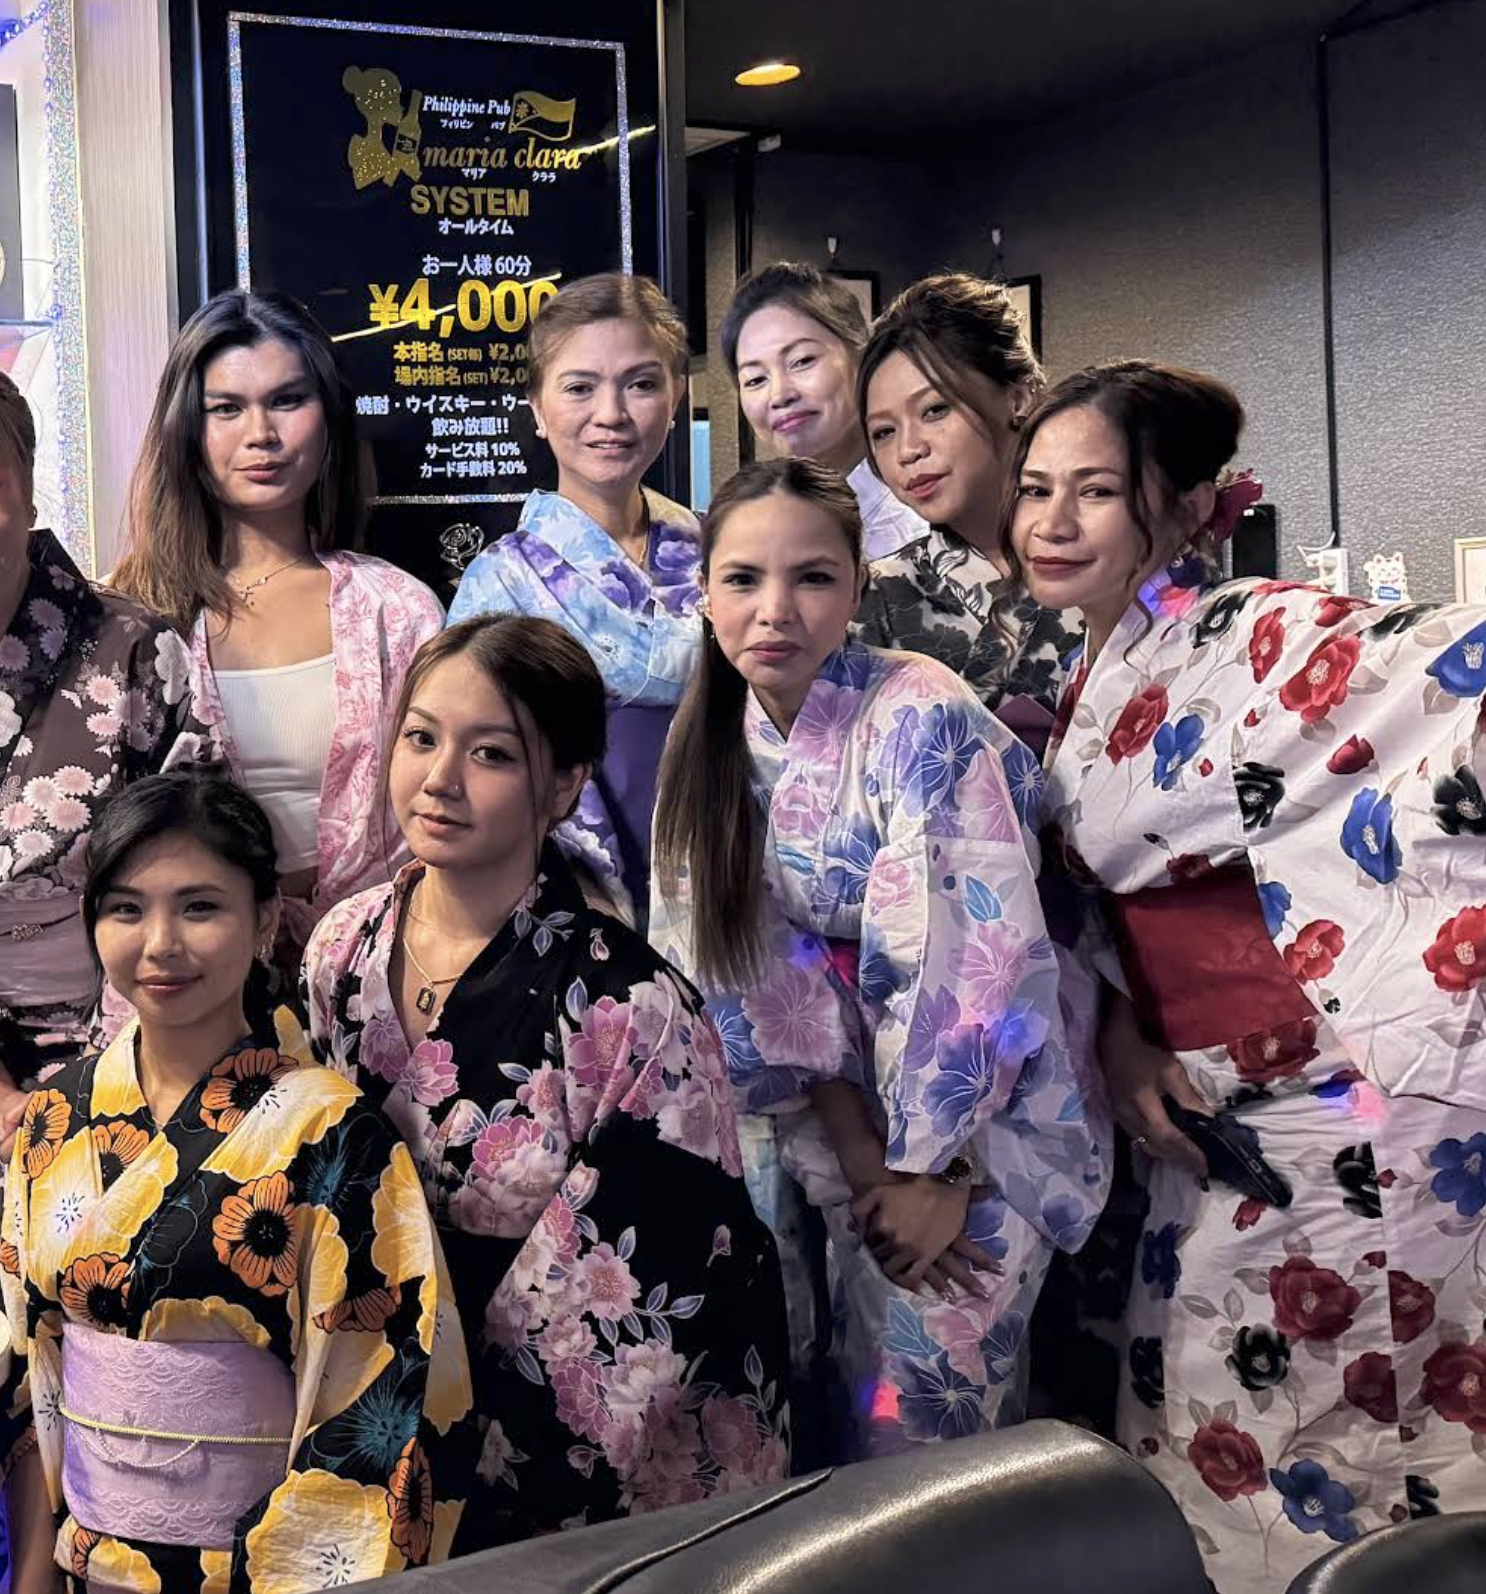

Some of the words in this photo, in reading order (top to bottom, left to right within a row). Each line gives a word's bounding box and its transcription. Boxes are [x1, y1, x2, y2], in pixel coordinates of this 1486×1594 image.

[422, 95, 485, 117] Philippine
[487, 100, 511, 116] Pub
[423, 136, 508, 168] maria
[514, 137, 582, 170] clara
[461, 168, 487, 180] マリア
[532, 170, 557, 183] クララ
[410, 184, 530, 217] SYSTEM
[438, 217, 514, 235] オールタイム
[422, 254, 492, 276] お一人様
[495, 255, 532, 276] 60分
[368, 277, 559, 338] ¥4,000
[393, 340, 444, 363] 本指名
[488, 342, 531, 363] ¥2,0
[394, 365, 462, 386] 場内指名
[489, 365, 531, 386] ¥2,0
[425, 441, 489, 459] サービス料
[491, 441, 521, 457] 10%
[420, 460, 496, 478] カード手数料
[498, 460, 528, 475] 20%
